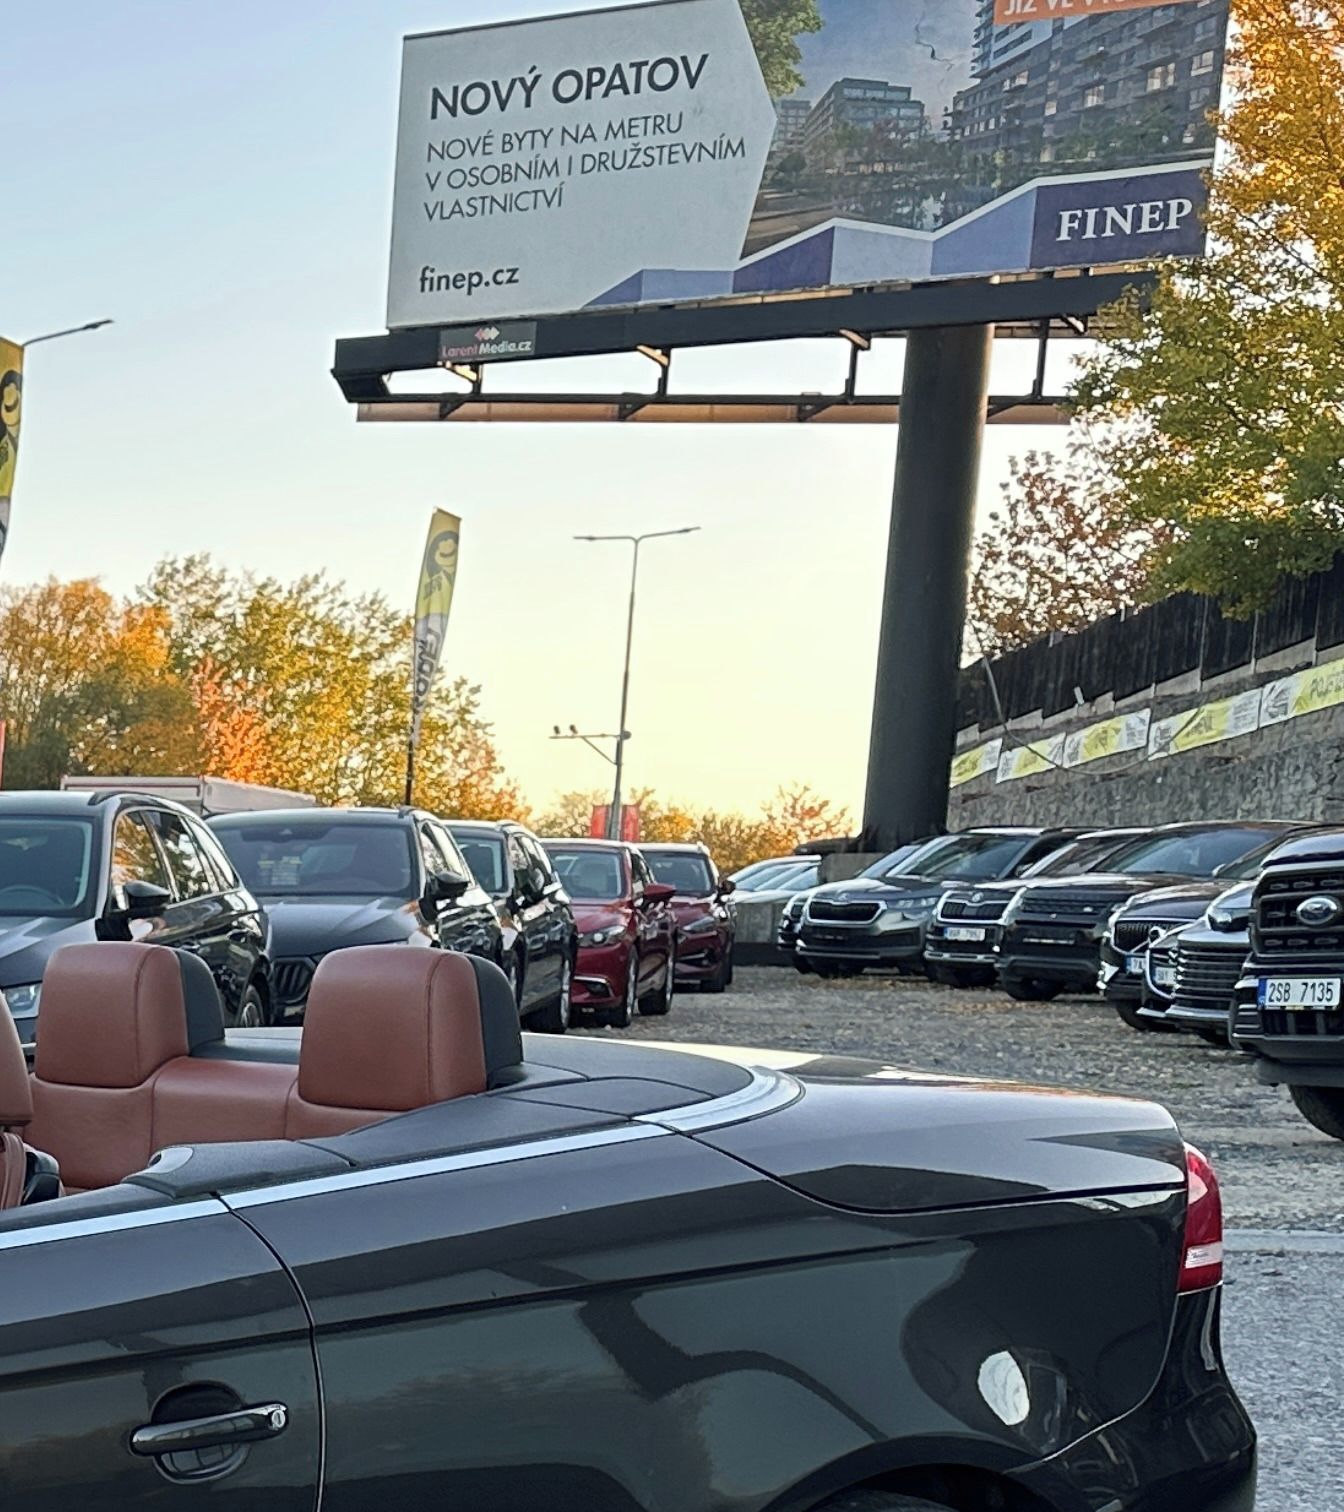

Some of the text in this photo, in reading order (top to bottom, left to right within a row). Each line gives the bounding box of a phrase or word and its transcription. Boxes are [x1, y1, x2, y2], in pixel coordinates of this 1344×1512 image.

[430, 53, 710, 121] NOVÝ OPATOV
[426, 111, 684, 163] NOVÉ BYTY NA METRU
[425, 133, 747, 192] V OSOBNÍM I DRUŽSTEVNÍM
[423, 181, 566, 222] VLASTNICTVÍ
[1056, 197, 1194, 242] FINEP
[418, 266, 520, 296] finep.cz
[1267, 982, 1334, 1003] 2SB 7135
